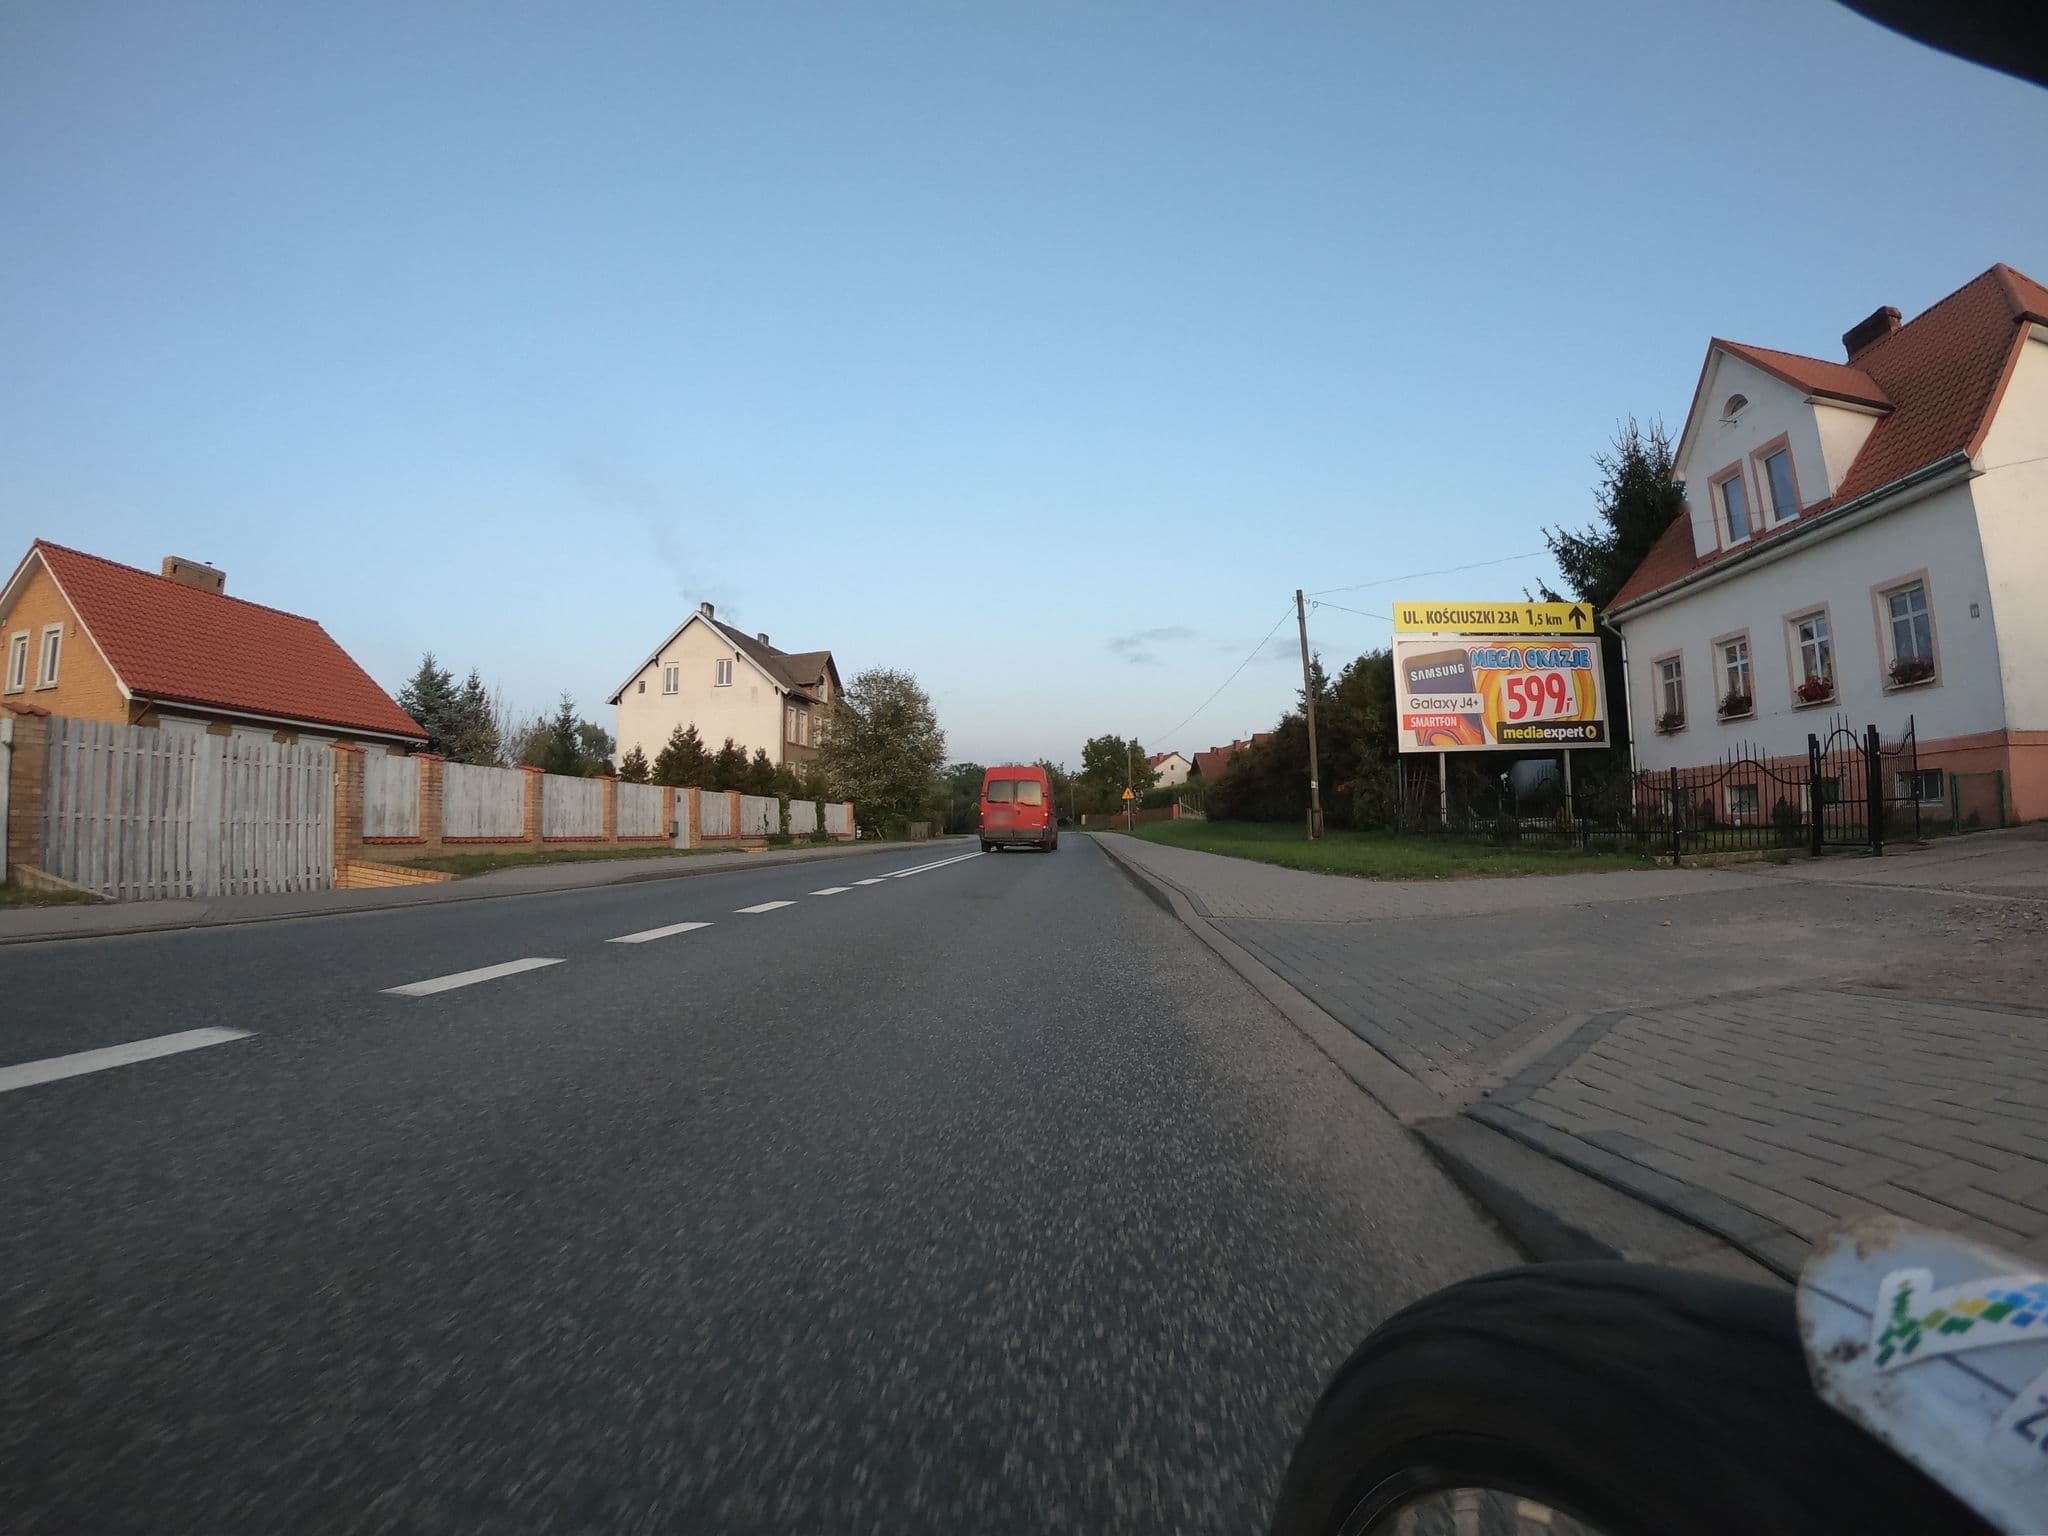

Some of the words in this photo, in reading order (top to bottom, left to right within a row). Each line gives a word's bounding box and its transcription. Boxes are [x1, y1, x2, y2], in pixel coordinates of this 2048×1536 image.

[1403, 610, 1423, 624] UL.
[1426, 608, 1494, 625] KOŚCIUSZKI
[1498, 611, 1519, 624] 23A
[1526, 609, 1543, 626] 1,5
[1546, 614, 1562, 626] km
[1471, 648, 1521, 668] MEGA
[1525, 648, 1590, 668] OKAZJE
[1410, 664, 1465, 682] SAMSUNG
[1410, 697, 1458, 711] Galaxy
[1460, 698, 1479, 709] J4+
[1410, 716, 1457, 727] SMARTFON
[1503, 725, 1585, 740] mediaexpert
